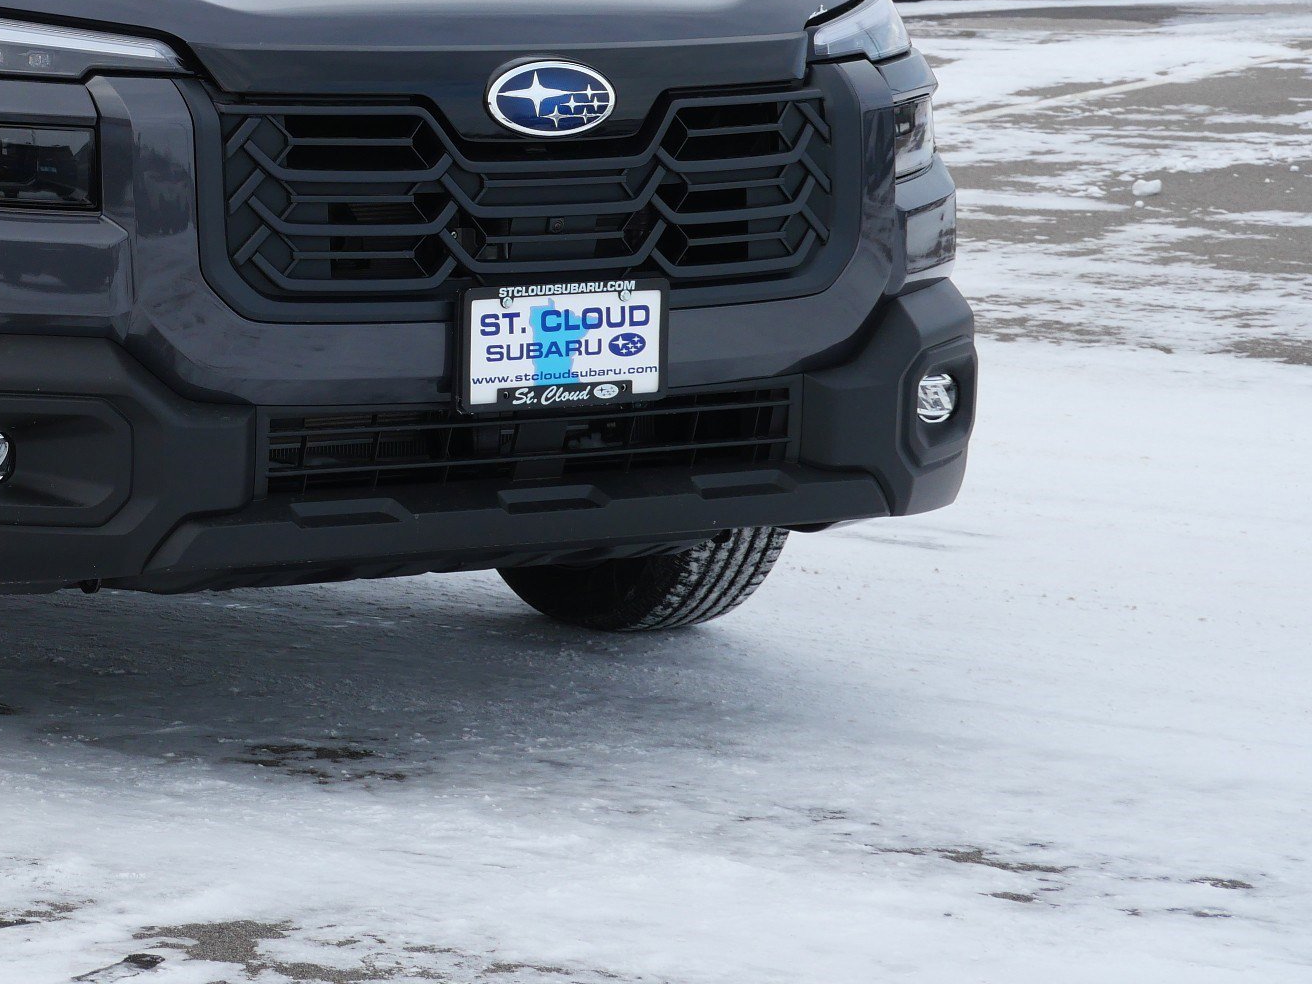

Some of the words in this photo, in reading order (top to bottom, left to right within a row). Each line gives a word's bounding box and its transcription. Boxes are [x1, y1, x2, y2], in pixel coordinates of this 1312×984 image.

[499, 280, 636, 298] STCLOUDSUBARU.COM
[479, 311, 527, 337] ST.
[540, 304, 651, 333] CLOUD
[485, 338, 602, 363] SUBARU
[472, 364, 658, 385] www.stcloudsubaru.com
[512, 387, 538, 405] St.
[540, 385, 590, 406] Cloud
